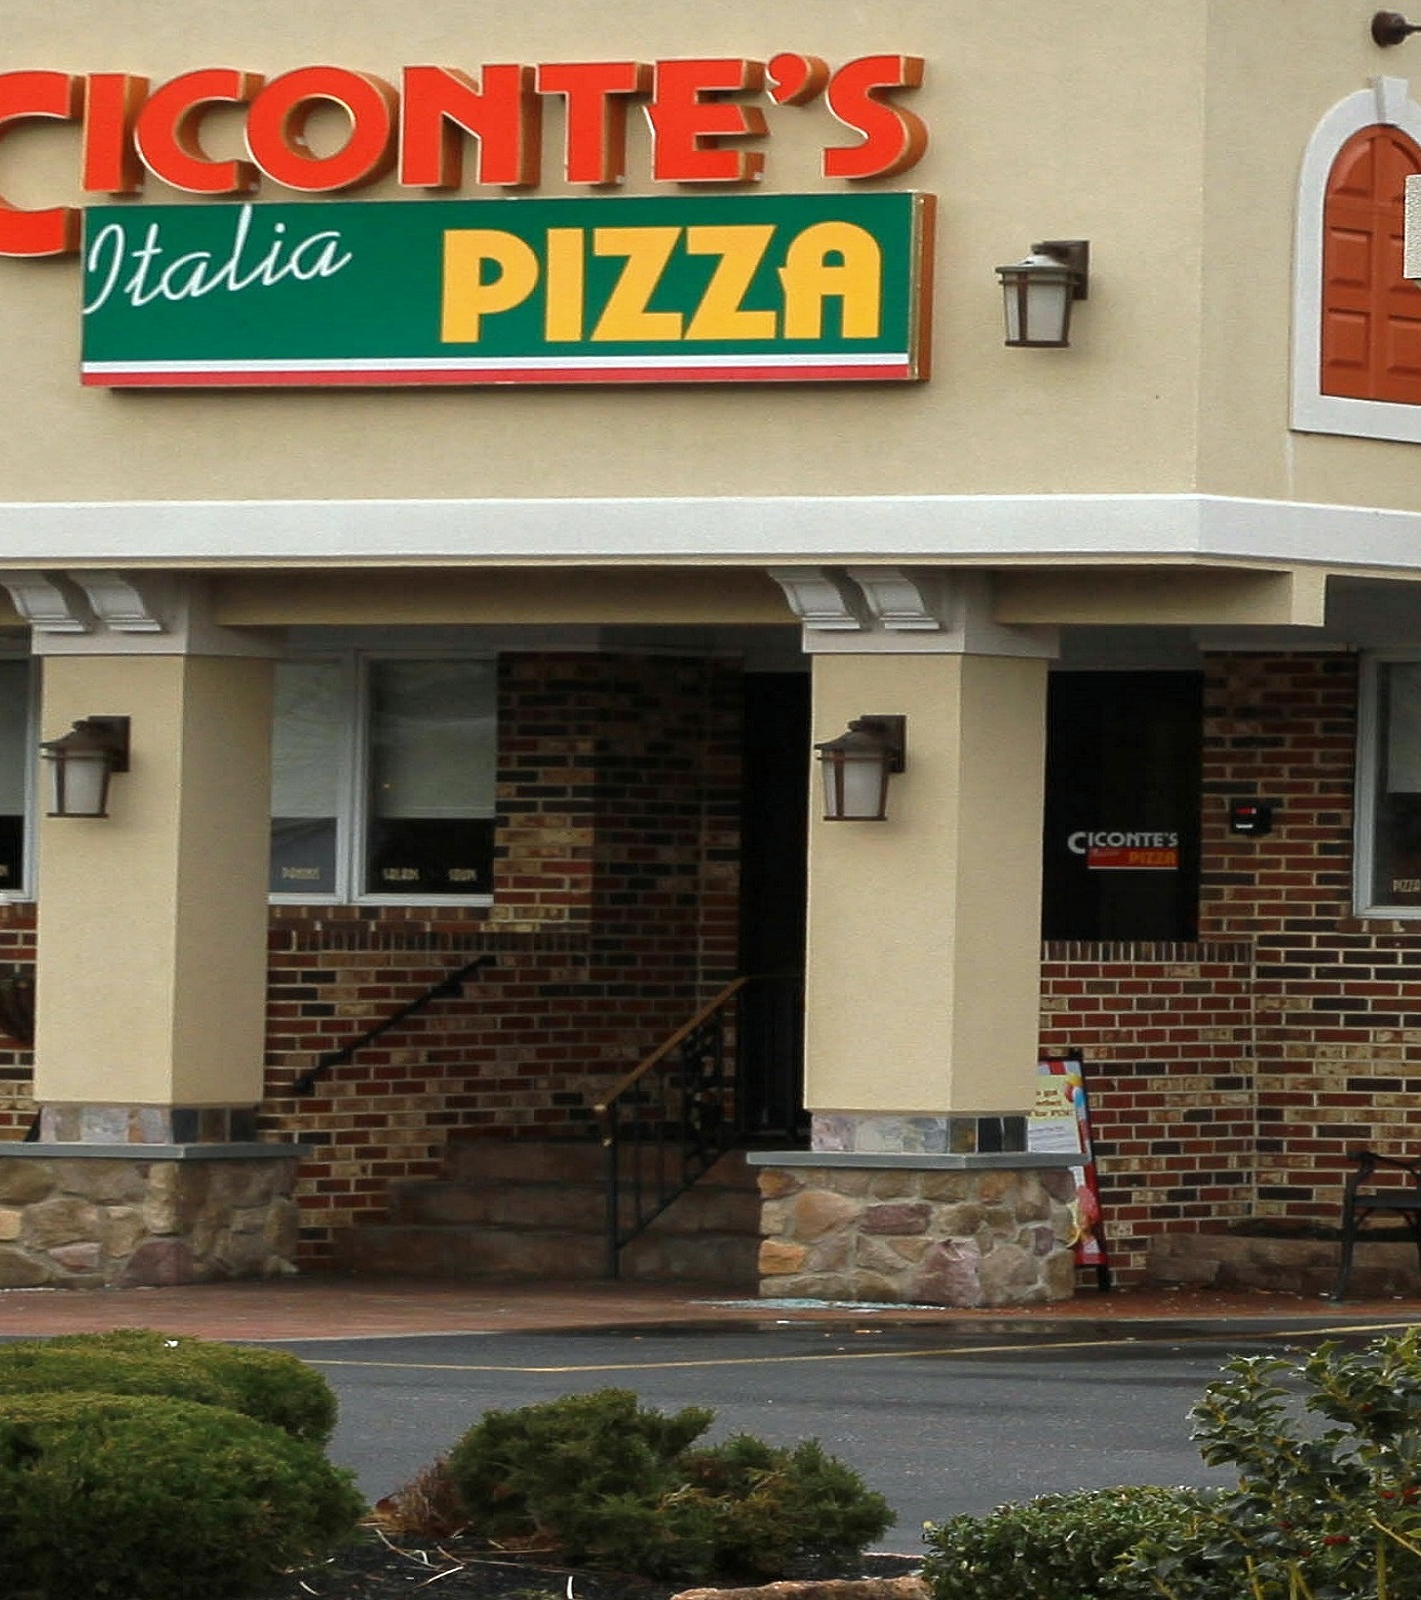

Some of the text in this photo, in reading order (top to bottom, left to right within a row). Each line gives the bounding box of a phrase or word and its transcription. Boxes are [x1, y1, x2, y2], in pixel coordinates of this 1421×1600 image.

[82, 203, 883, 344] Italia PIZZA
[1067, 831, 1179, 854] CICONTE'S
[1129, 851, 1177, 865] PIZZA
